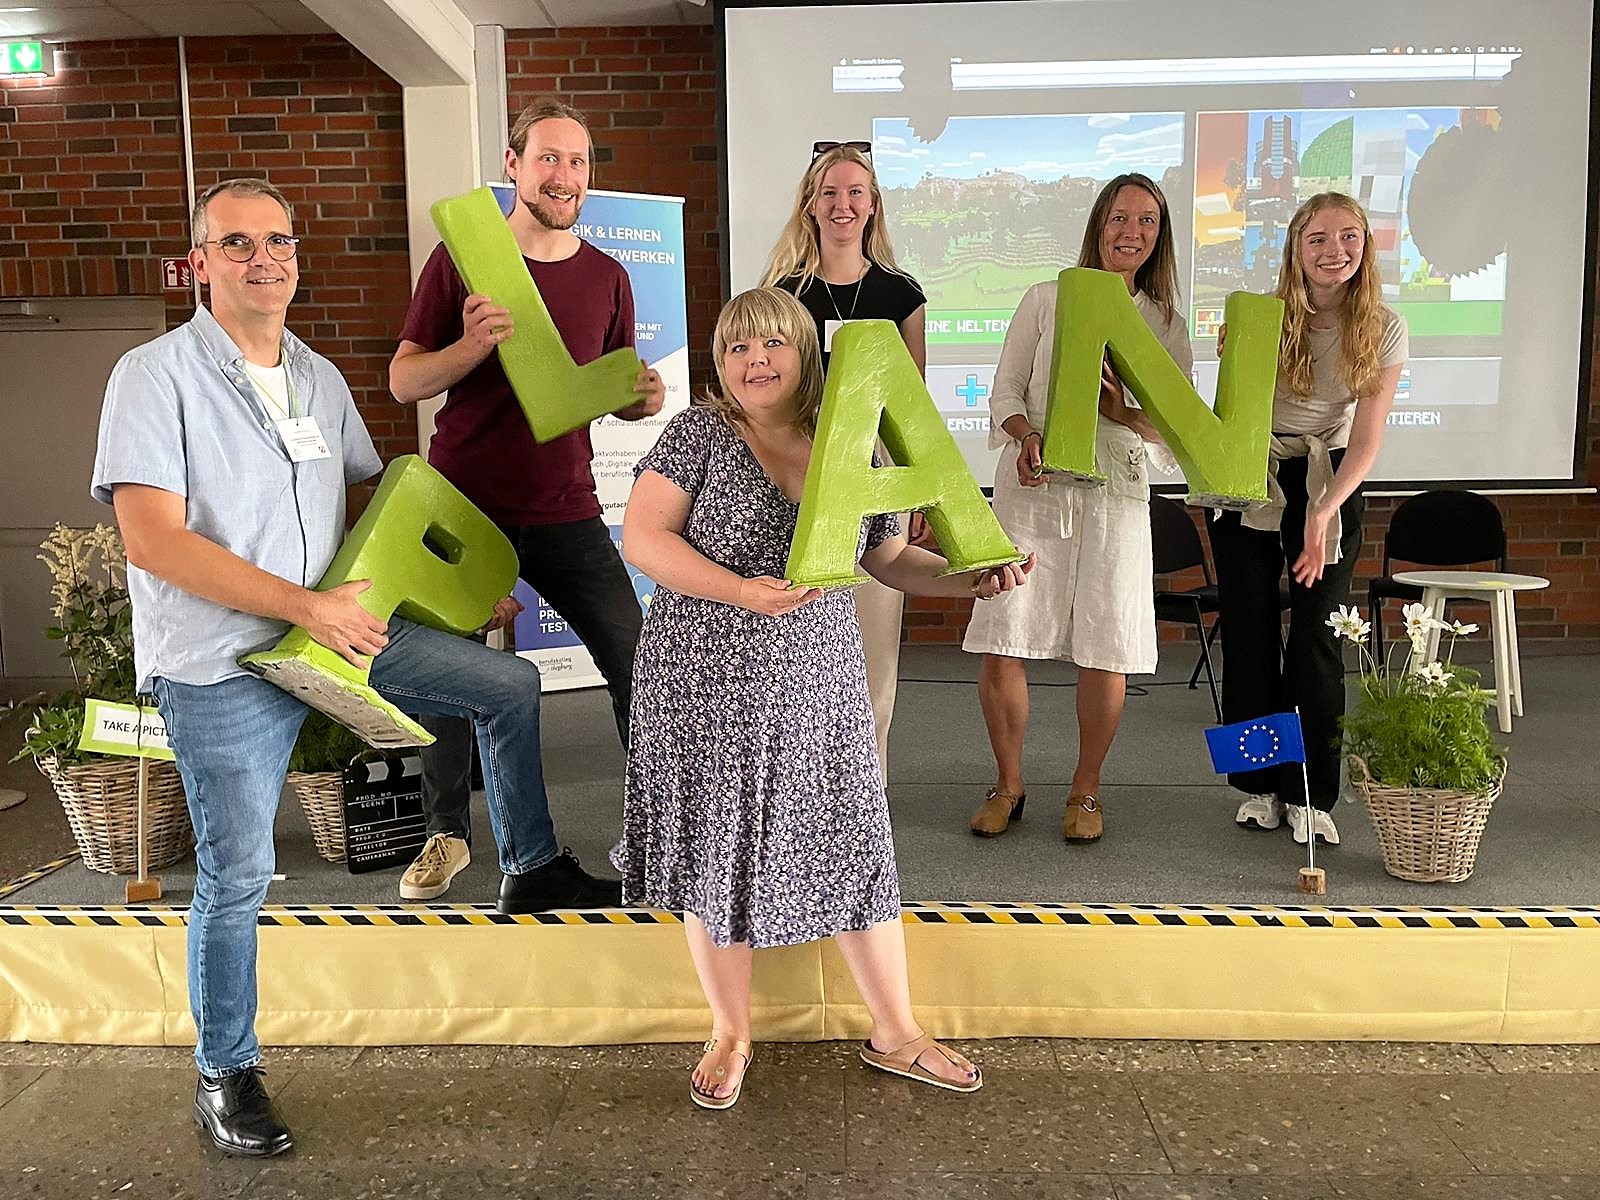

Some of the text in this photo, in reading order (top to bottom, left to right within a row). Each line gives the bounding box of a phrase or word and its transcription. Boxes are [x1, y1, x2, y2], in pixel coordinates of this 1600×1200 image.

[596, 225, 606, 238] &
[608, 226, 662, 242] LERNEN
[647, 322, 662, 331] MIT
[957, 320, 1010, 333] WELTEN
[636, 332, 655, 340] UND
[431, 187, 643, 444] L
[786, 319, 1028, 590] A
[1042, 267, 1285, 510] N
[1385, 411, 1441, 425] TIEREN
[540, 622, 568, 633] TEST
[103, 719, 131, 733] TAKE
